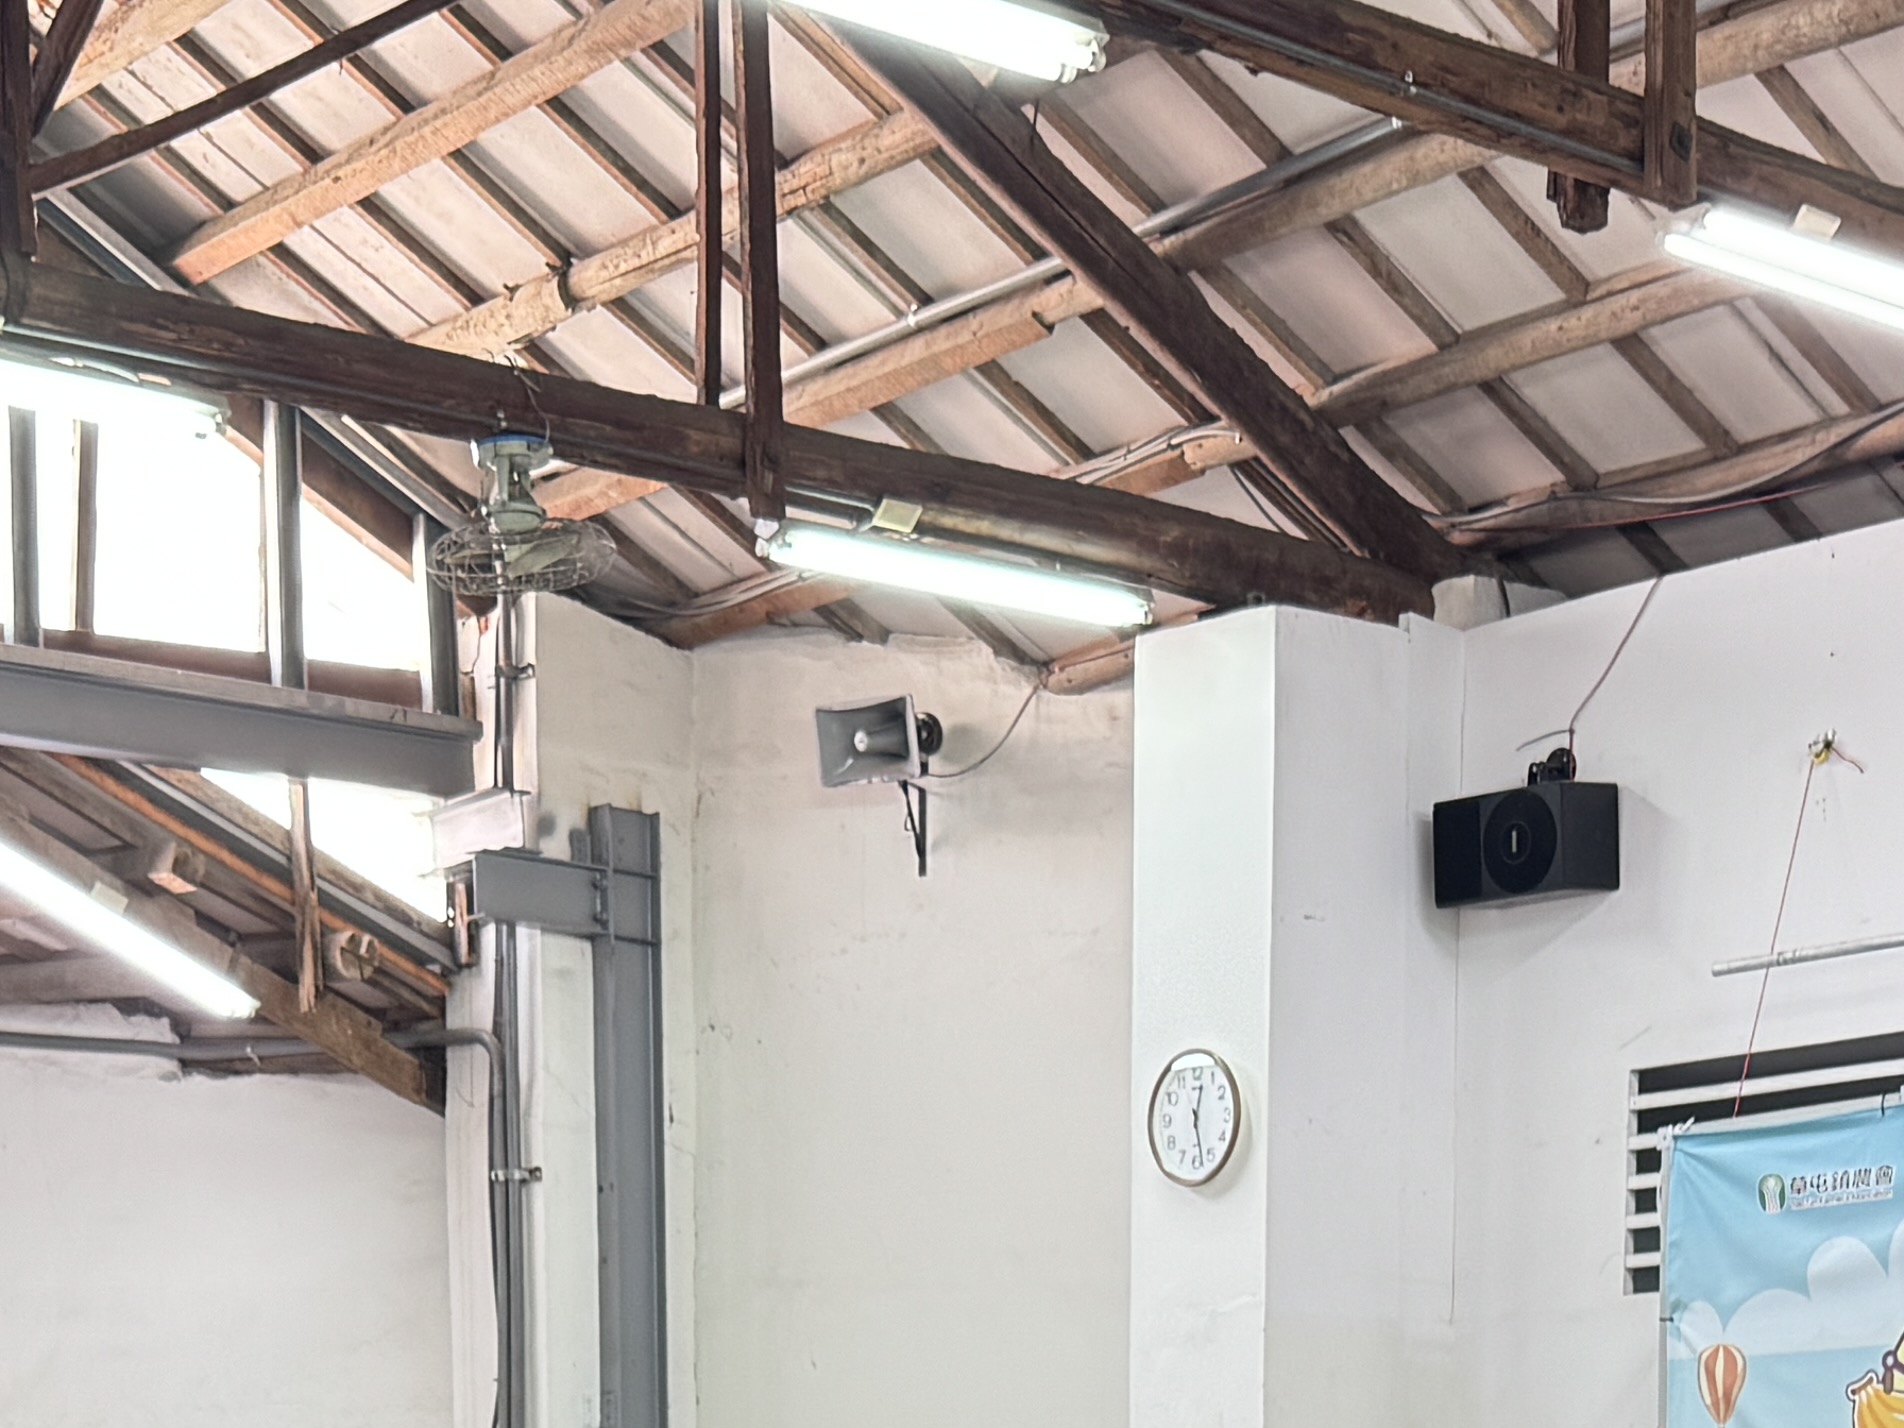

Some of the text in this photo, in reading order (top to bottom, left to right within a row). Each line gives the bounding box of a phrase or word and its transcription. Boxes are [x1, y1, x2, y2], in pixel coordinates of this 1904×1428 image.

[1166, 1091, 1179, 1106] 10
[1217, 1085, 1227, 1100] 2
[1163, 1113, 1172, 1128] 9
[1223, 1107, 1232, 1123] 3
[1167, 1135, 1176, 1150] 8
[1217, 1130, 1227, 1142] 4
[1179, 1149, 1186, 1165] 7
[1206, 1147, 1215, 1162] 5
[1191, 1155, 1202, 1170] 6
